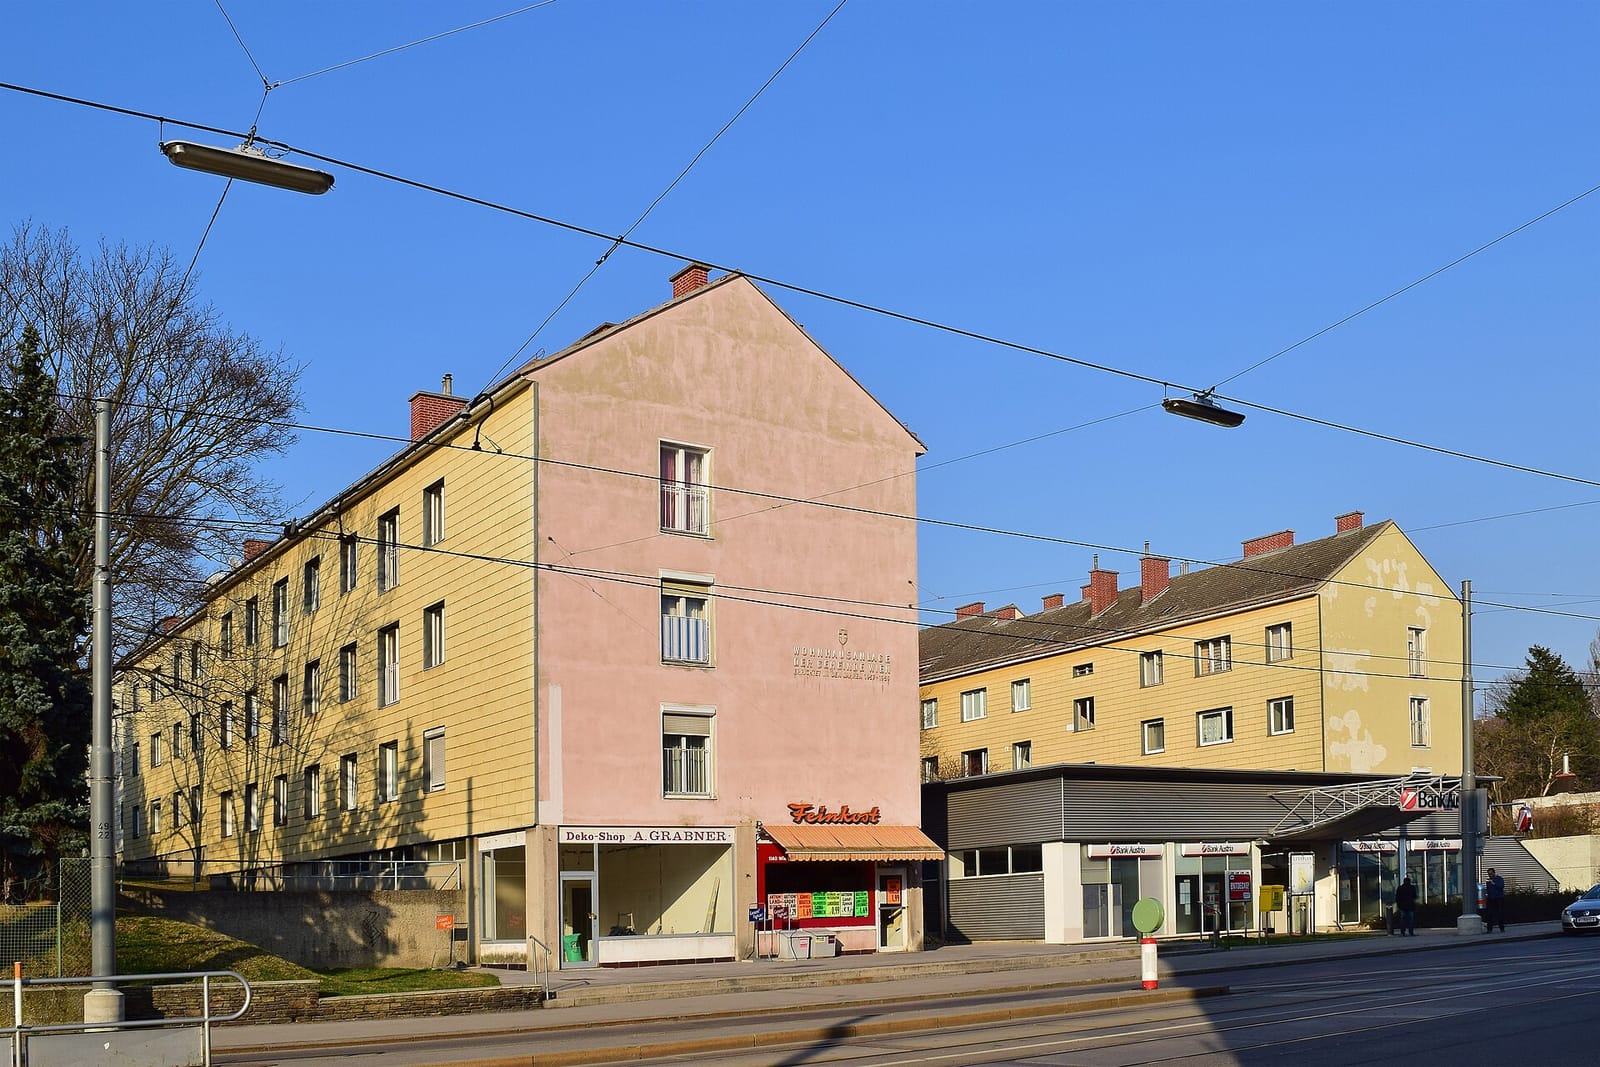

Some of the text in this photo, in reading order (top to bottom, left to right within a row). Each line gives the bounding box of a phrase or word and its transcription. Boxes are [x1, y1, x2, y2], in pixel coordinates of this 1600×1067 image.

[787, 803, 881, 825] Feinkost
[566, 831, 626, 843] Deko-Shop
[1116, 846, 1146, 854] Bank Austria
[1207, 844, 1234, 852] Bank Austria
